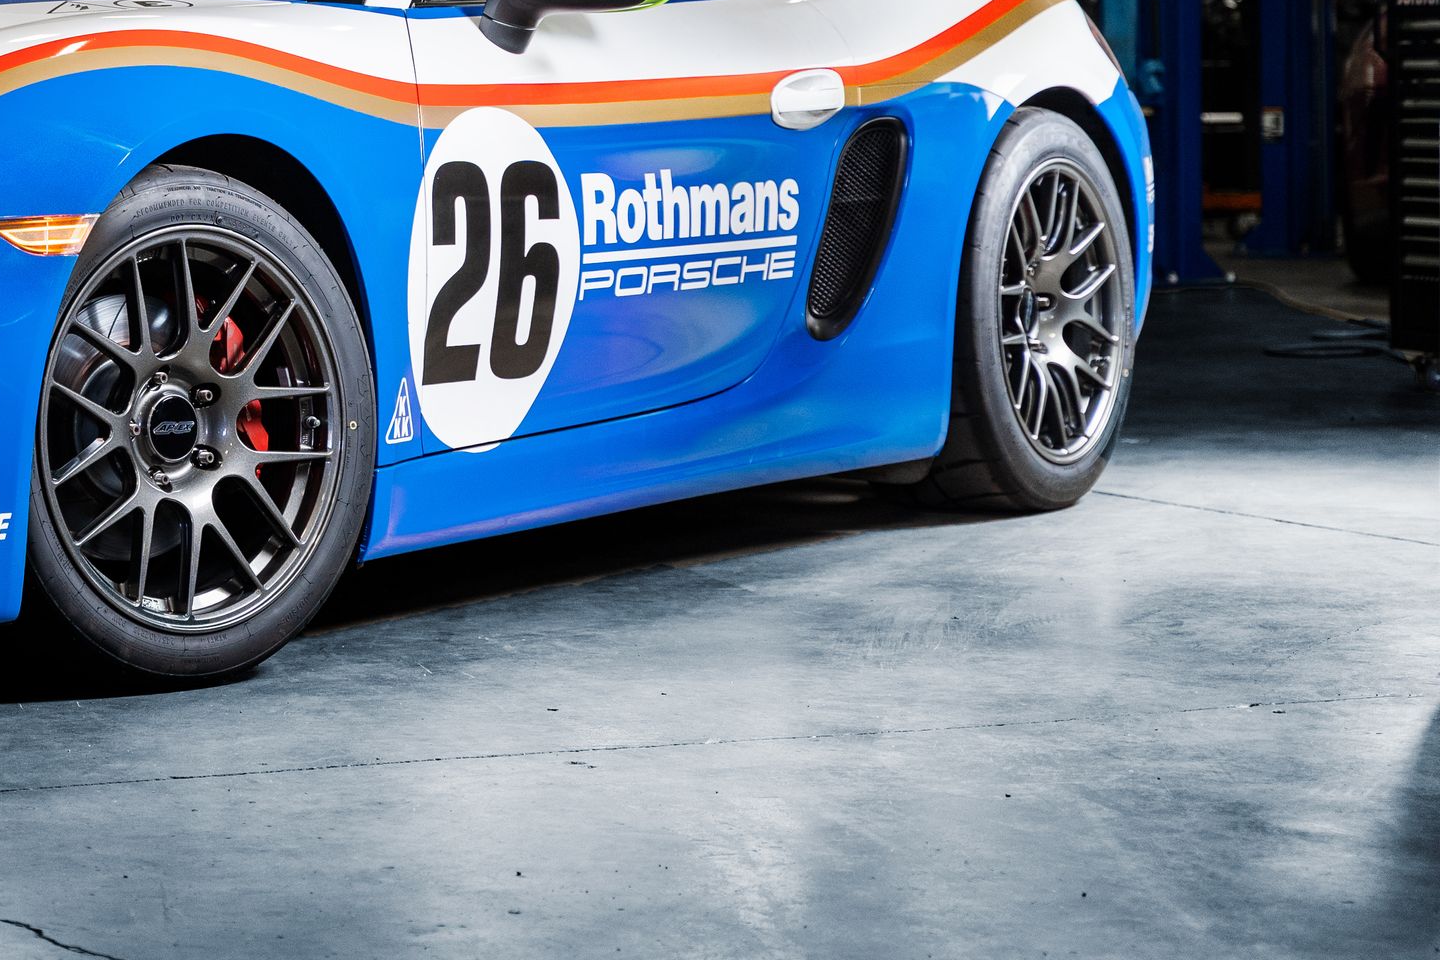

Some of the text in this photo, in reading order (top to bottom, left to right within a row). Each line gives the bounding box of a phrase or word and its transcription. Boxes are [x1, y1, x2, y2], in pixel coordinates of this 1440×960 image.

[580, 168, 800, 246] Rothmans
[422, 160, 561, 386] 26
[578, 250, 796, 301] PORSCHE
[154, 421, 195, 434] APEX
